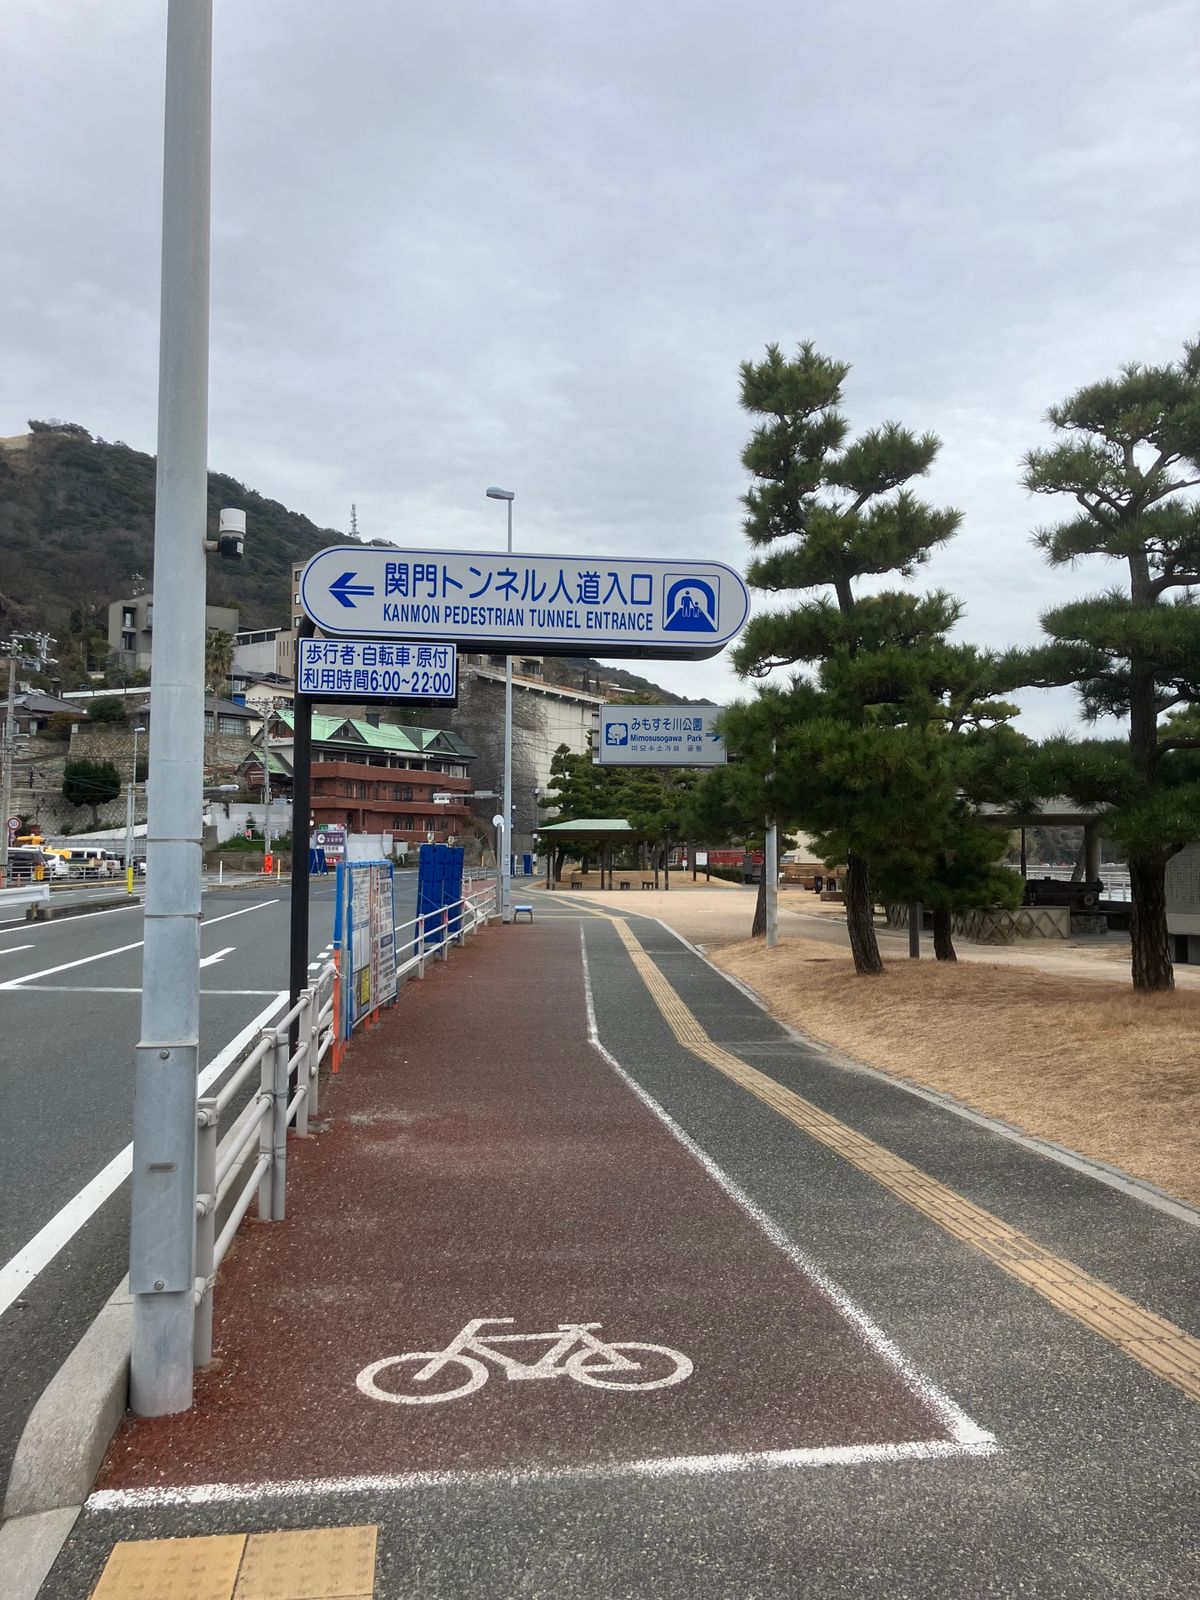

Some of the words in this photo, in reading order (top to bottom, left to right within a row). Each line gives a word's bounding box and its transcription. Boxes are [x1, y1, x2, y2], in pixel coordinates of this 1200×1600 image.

[385, 562, 653, 605] 関門トンネル人道入口
[383, 603, 440, 623] KANMON
[444, 606, 524, 626] PEDESTRIAN
[529, 609, 581, 629] TUNNEL
[586, 611, 653, 631] ENTRANCE
[631, 717, 703, 731] みもすそ川公園
[630, 734, 682, 743] Mimosusogawa
[687, 734, 703, 742] Park
